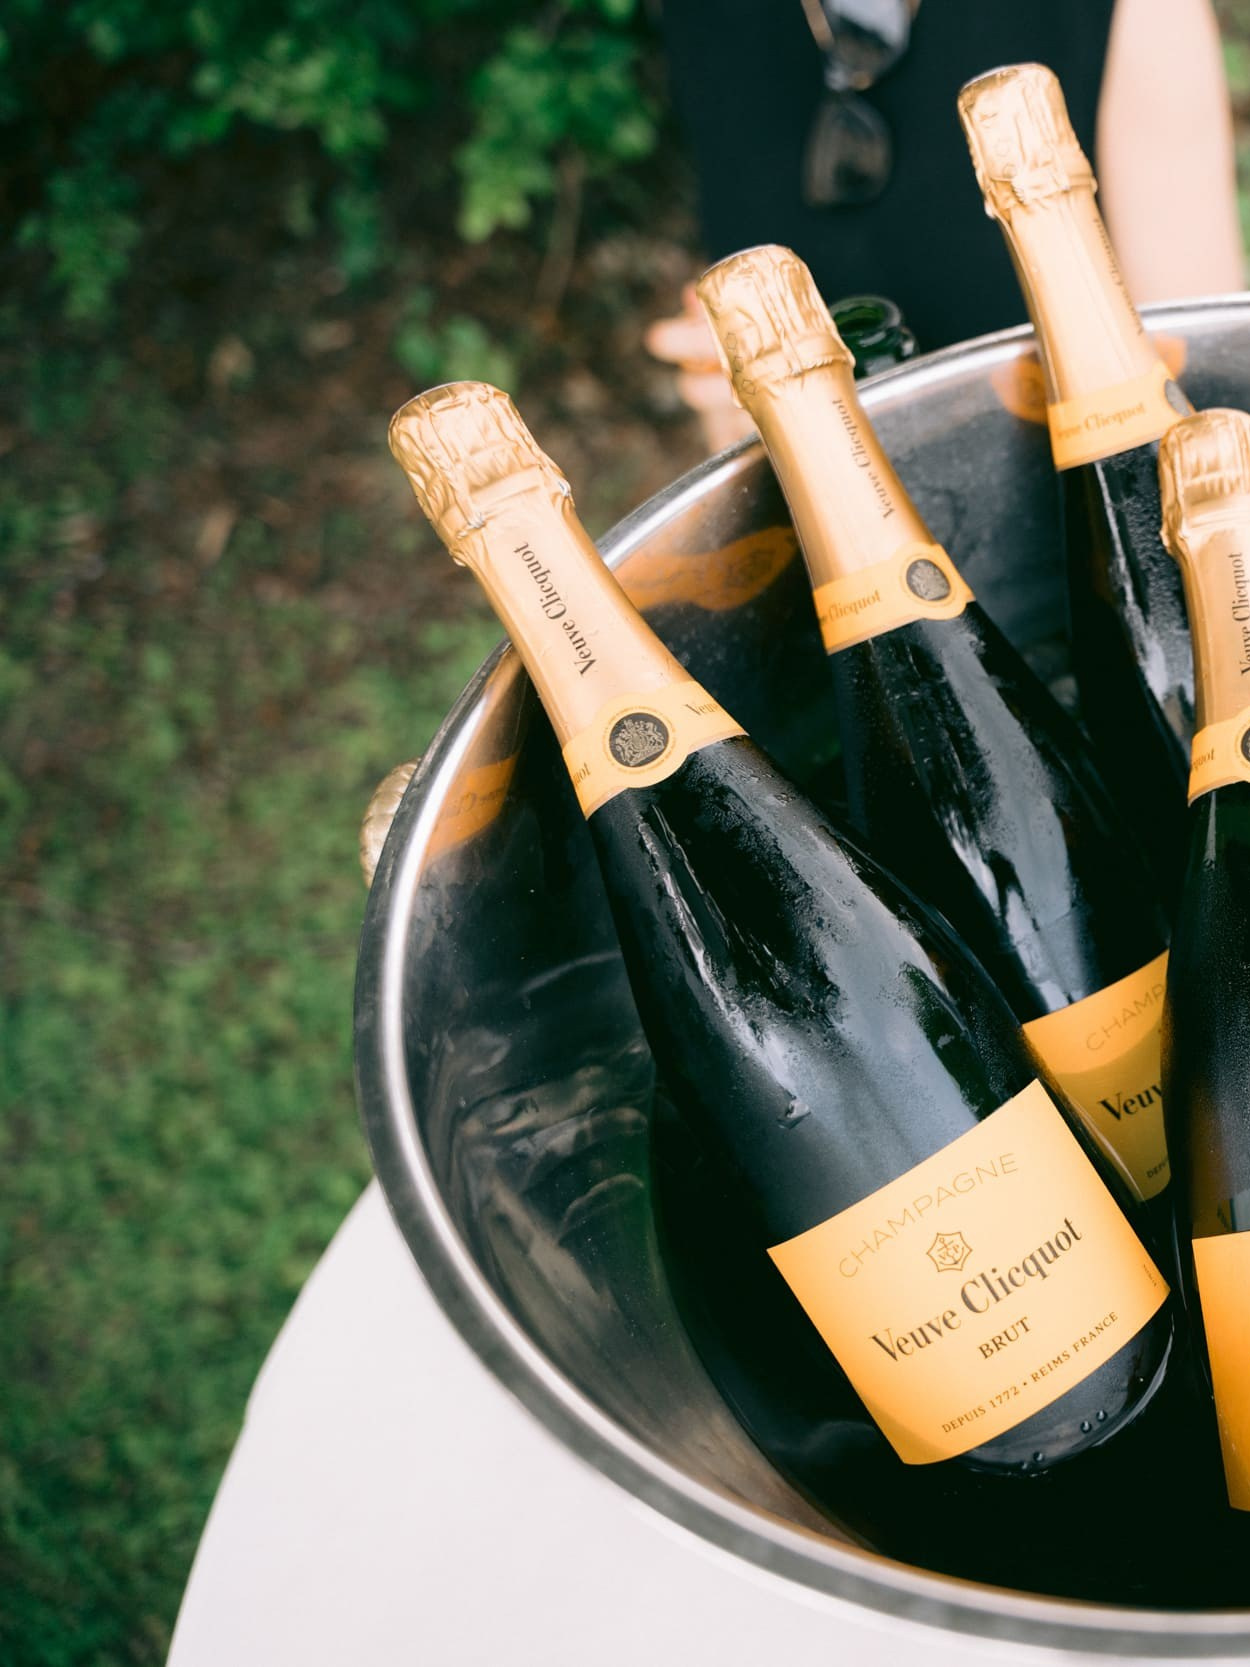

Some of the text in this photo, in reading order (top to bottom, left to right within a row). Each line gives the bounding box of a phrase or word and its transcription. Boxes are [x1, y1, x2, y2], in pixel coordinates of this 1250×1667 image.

[513, 541, 599, 677] Veuve Clicquot
[1227, 551, 1250, 624] Clicquot
[838, 1152, 1020, 1279] CHAMPAGNE
[869, 1216, 1083, 1363] Veuve Clicquot
[977, 1316, 1033, 1360] BRUT
[941, 1311, 1119, 1434] DEPUIS 1772 REIMS FRANCE
